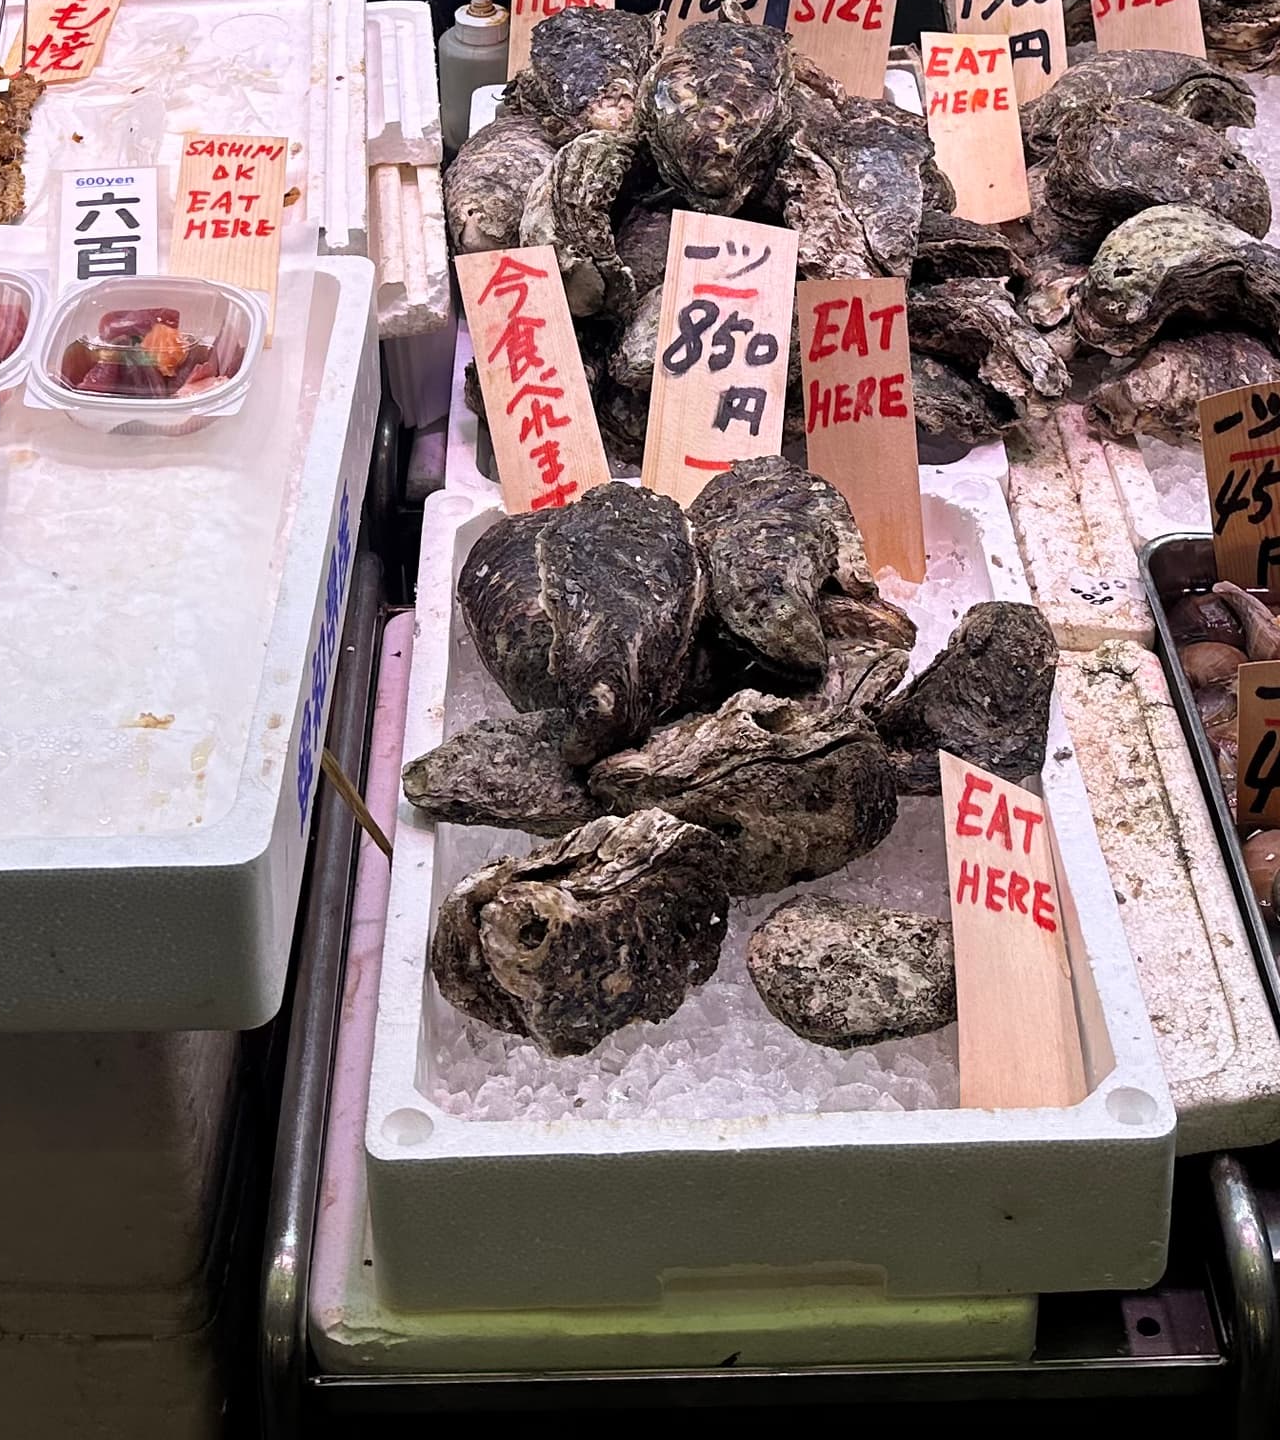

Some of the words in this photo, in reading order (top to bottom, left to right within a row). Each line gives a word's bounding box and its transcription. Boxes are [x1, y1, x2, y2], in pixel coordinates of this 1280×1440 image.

[926, 47, 1006, 79] EAT
[930, 87, 1010, 116] HERE
[185, 139, 286, 161] SASHIMI
[75, 175, 136, 187] 600yen
[186, 192, 260, 214] EAT
[183, 219, 276, 240] HERE
[661, 298, 780, 375] 850
[807, 296, 906, 363] EAT
[806, 372, 908, 434] HERE
[956, 772, 1043, 854] EAT
[956, 859, 1057, 933] HERE
